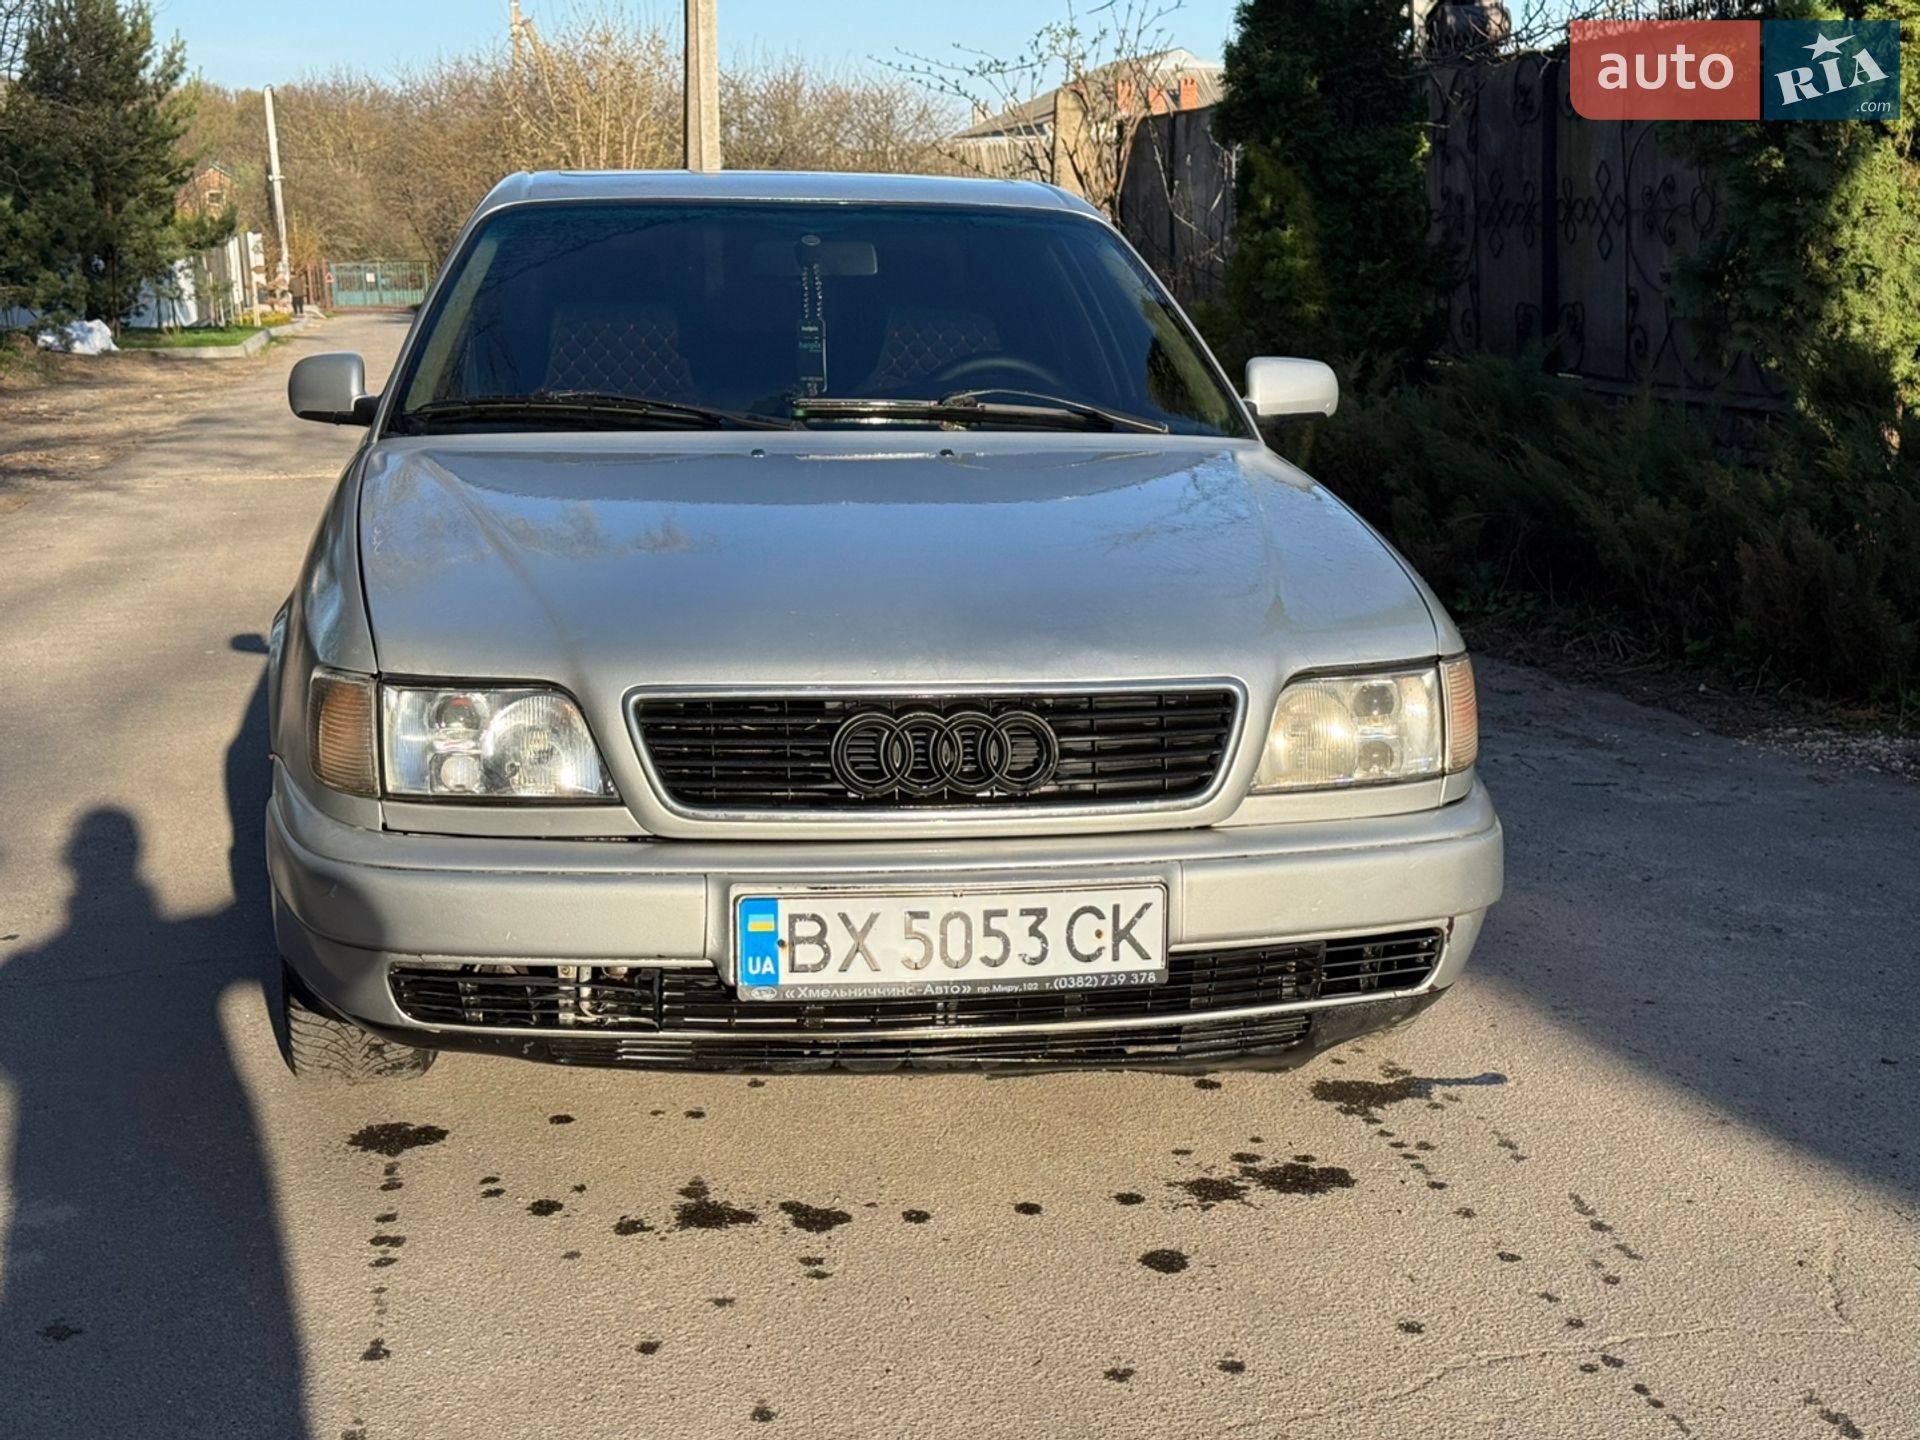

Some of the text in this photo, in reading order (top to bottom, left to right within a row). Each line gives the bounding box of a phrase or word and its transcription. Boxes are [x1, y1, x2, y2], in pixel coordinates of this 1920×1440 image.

[787, 902, 1153, 974] BX 5053 CK
[747, 958, 776, 975] UA
[1101, 974, 1127, 987] 739
[1130, 972, 1156, 984] 378
